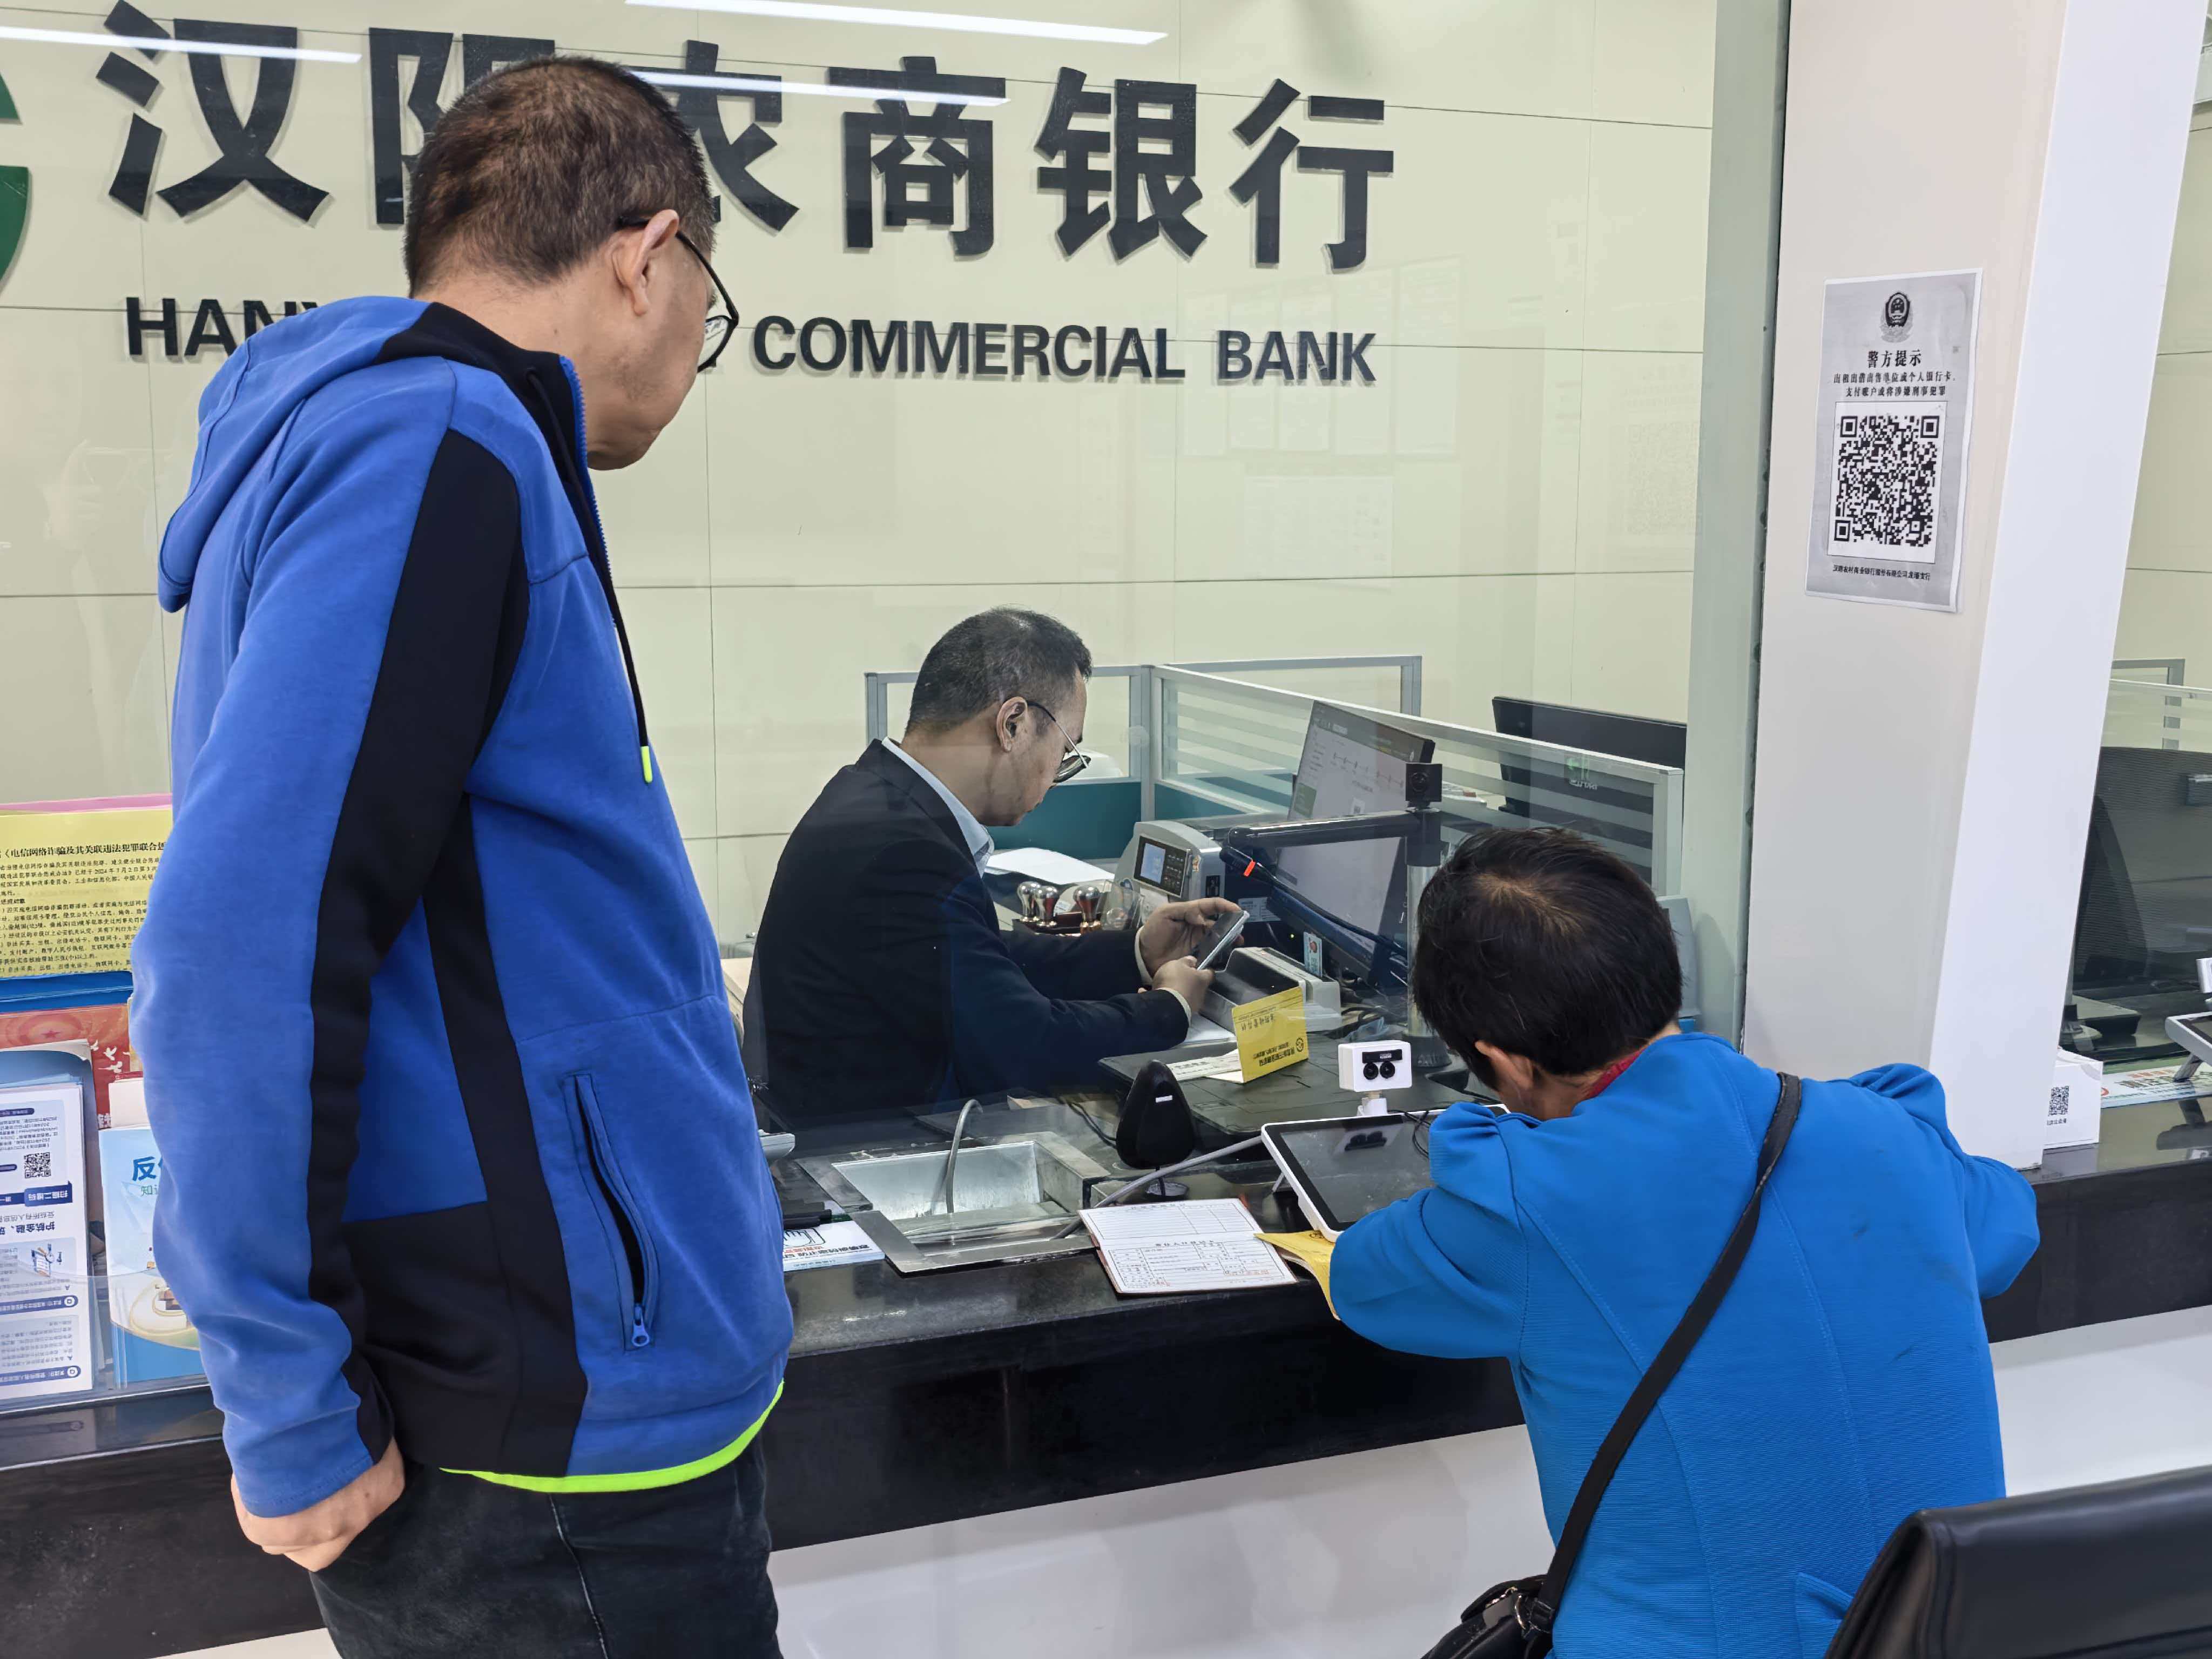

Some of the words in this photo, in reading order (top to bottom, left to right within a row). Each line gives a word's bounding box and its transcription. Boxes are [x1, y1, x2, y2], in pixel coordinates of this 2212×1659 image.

[754, 315, 1185, 379] COMMERCIAL
[1217, 330, 1377, 382] BANK
[1867, 349, 1921, 368] 警方提示
[132, 1156, 163, 1181] 反
